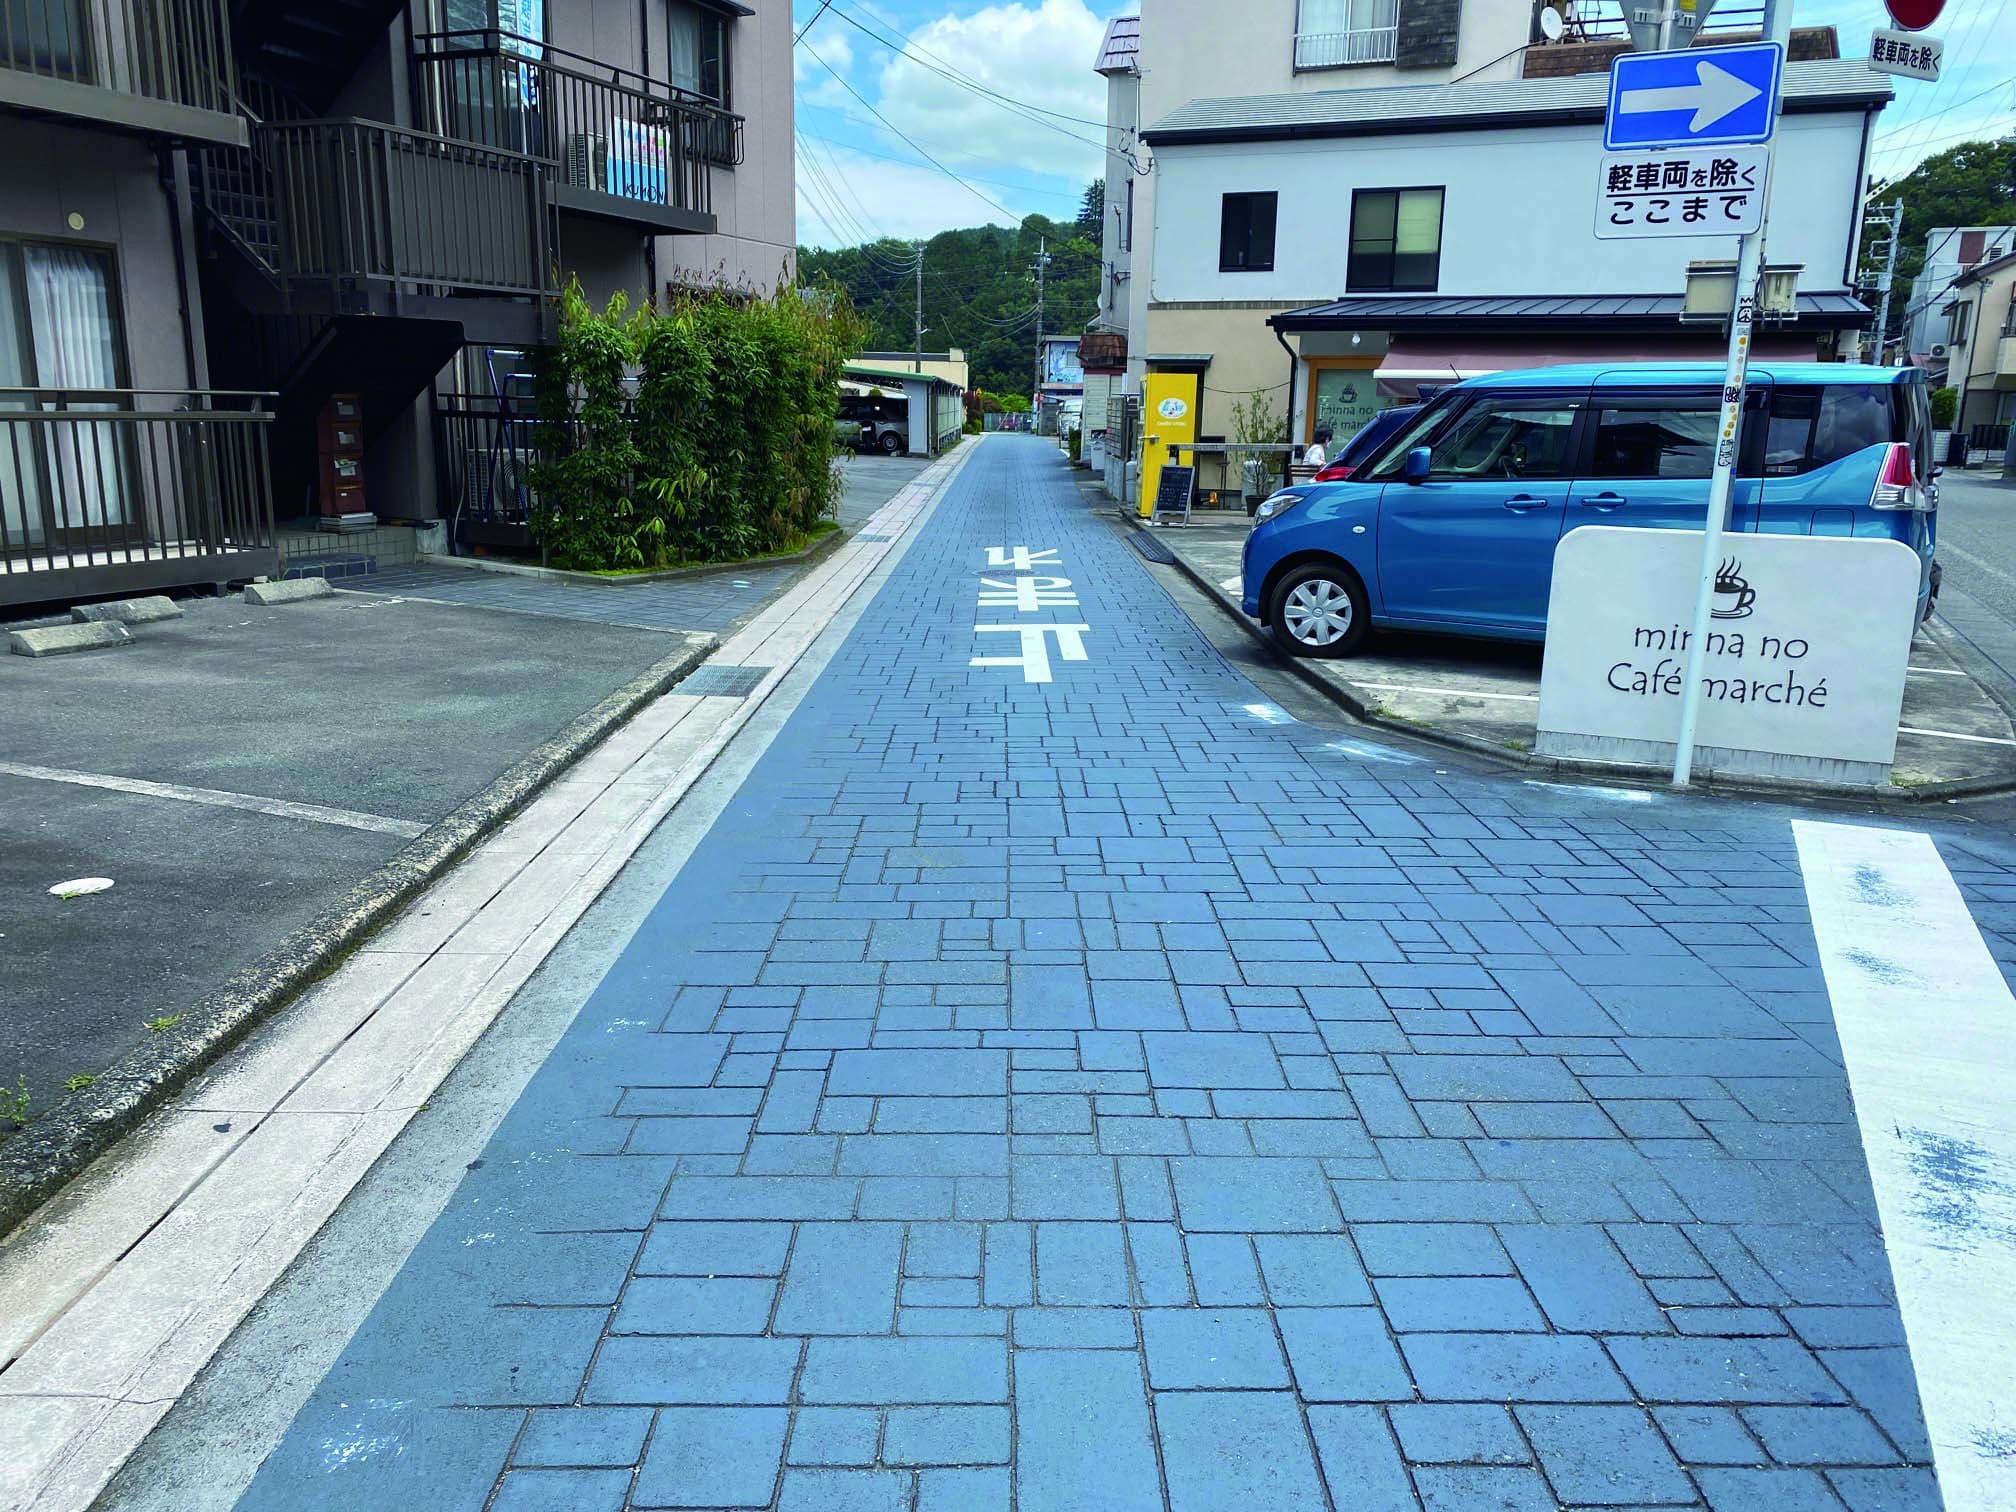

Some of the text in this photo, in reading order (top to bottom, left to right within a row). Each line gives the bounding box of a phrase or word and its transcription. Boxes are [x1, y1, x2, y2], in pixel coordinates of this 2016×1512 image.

[1872, 36, 1942, 73] 軽車両を除く
[1606, 158, 1756, 192] 軽車両を除く
[1610, 195, 1748, 225] ここまで
[969, 546, 1091, 683] 止まれ
[1760, 635, 1809, 659] no
[1607, 658, 1828, 708] Café marché
